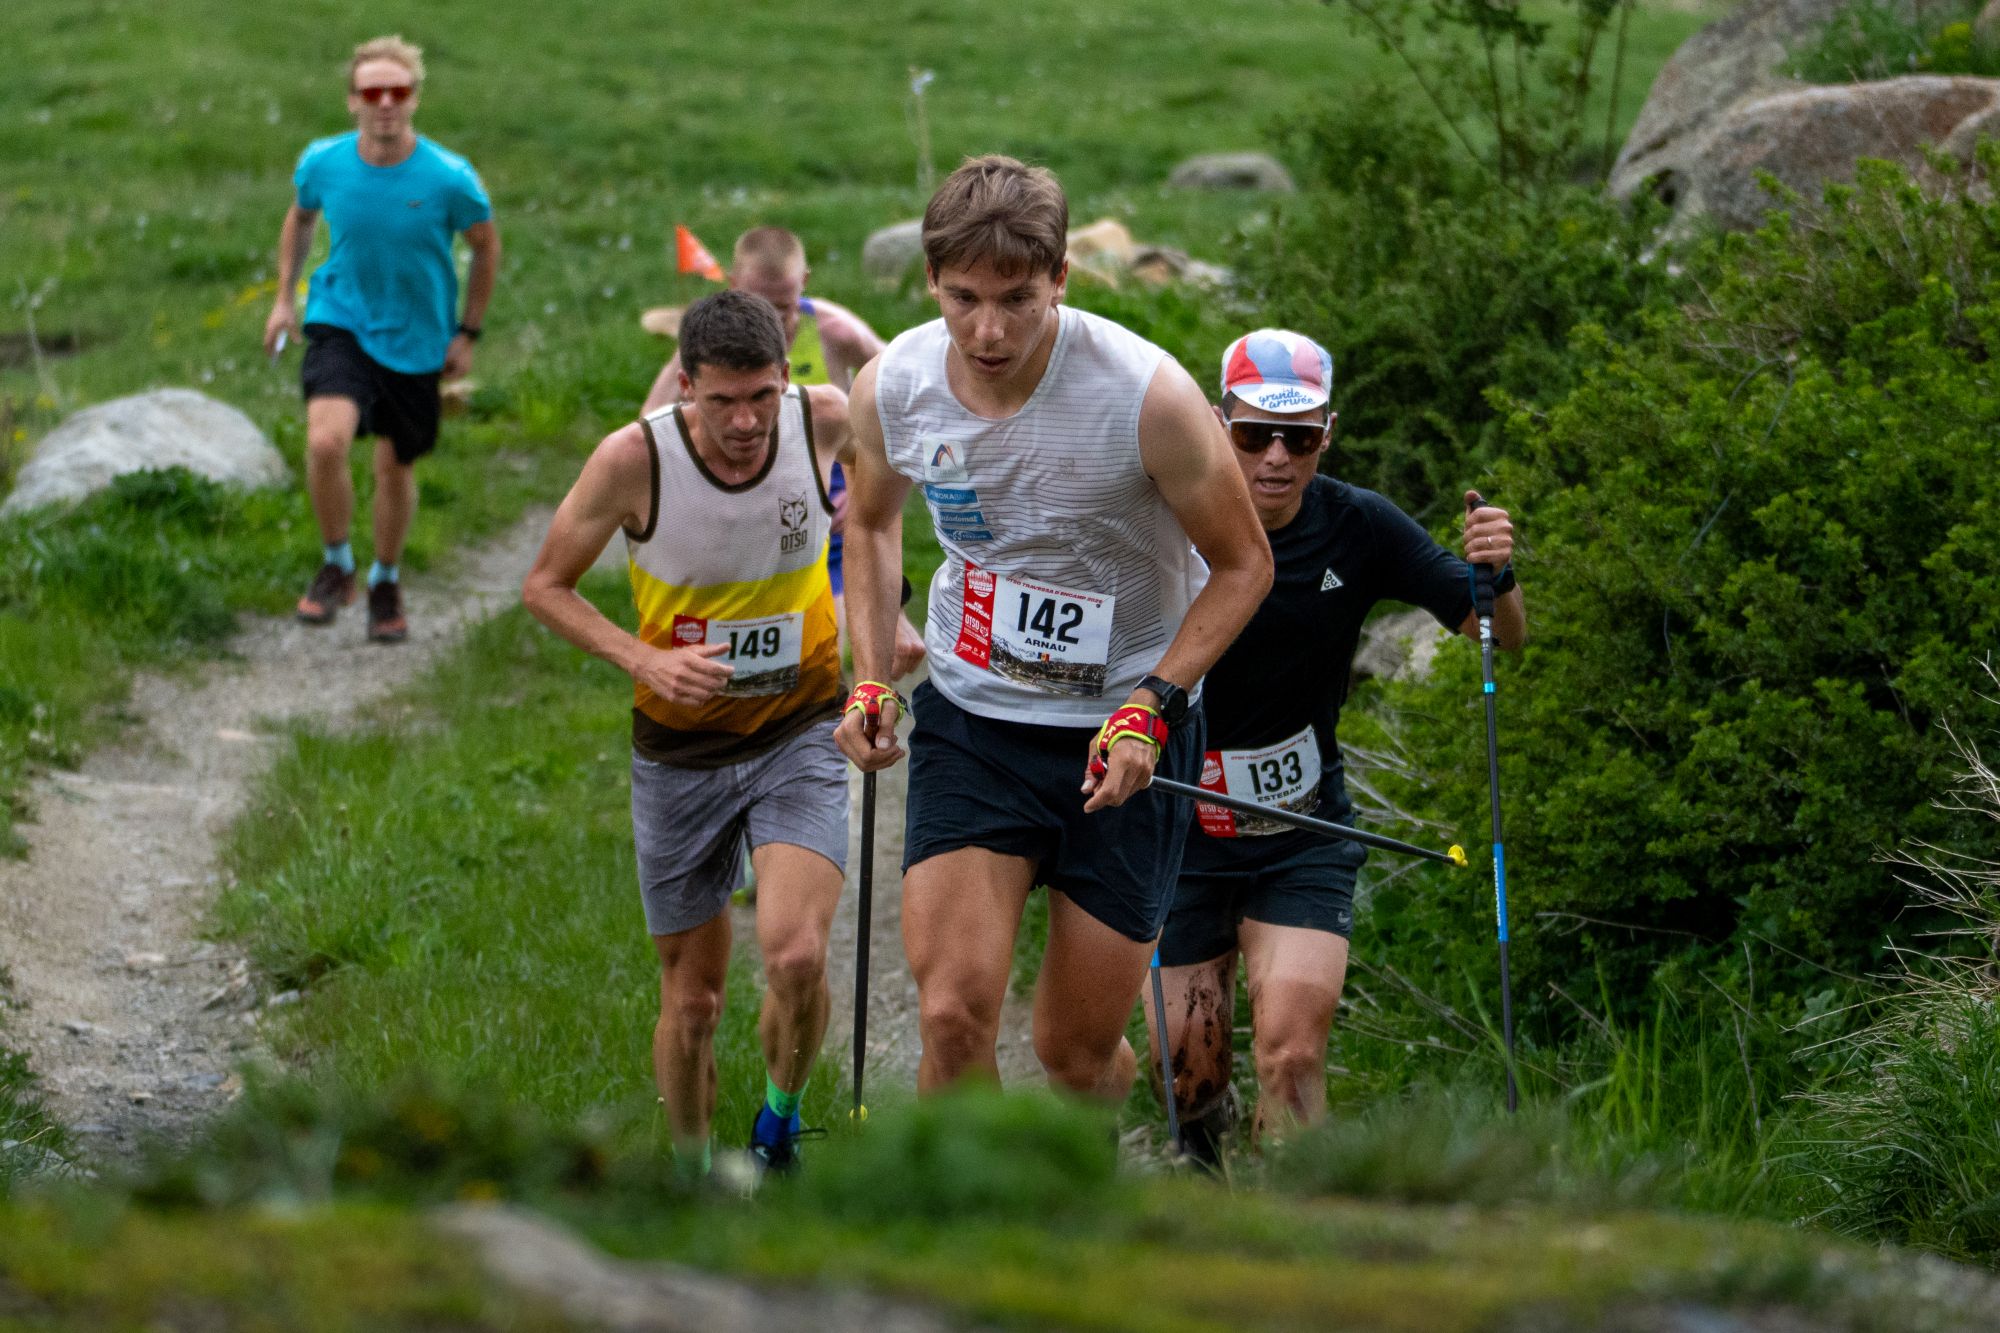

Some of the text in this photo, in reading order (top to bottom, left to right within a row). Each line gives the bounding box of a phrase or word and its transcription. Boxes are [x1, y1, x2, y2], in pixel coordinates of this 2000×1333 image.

[1258, 387, 1303, 407] grande
[780, 529, 808, 551] OTSO
[965, 613, 980, 630] OTSO
[1017, 592, 1084, 645] 142
[728, 626, 780, 660] 149
[1024, 637, 1068, 653] ARNAU
[1248, 750, 1303, 795] 133
[1257, 784, 1303, 803] ESTEBAN
